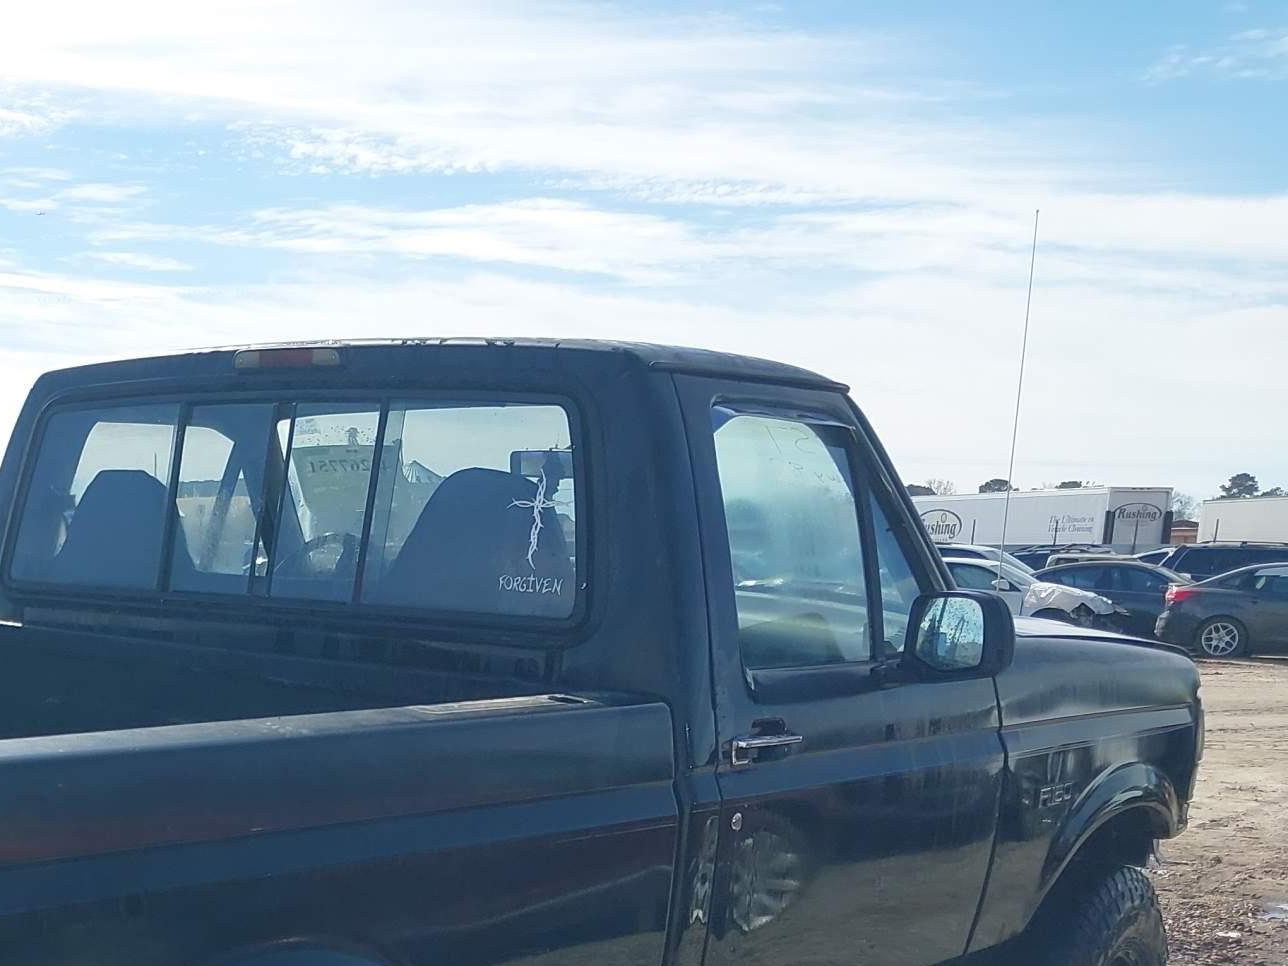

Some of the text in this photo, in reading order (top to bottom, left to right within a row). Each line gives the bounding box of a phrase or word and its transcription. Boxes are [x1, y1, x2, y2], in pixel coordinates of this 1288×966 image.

[1117, 507, 1159, 522] Rushing
[923, 518, 957, 539] ushing
[498, 574, 564, 596] FORGIVEN
